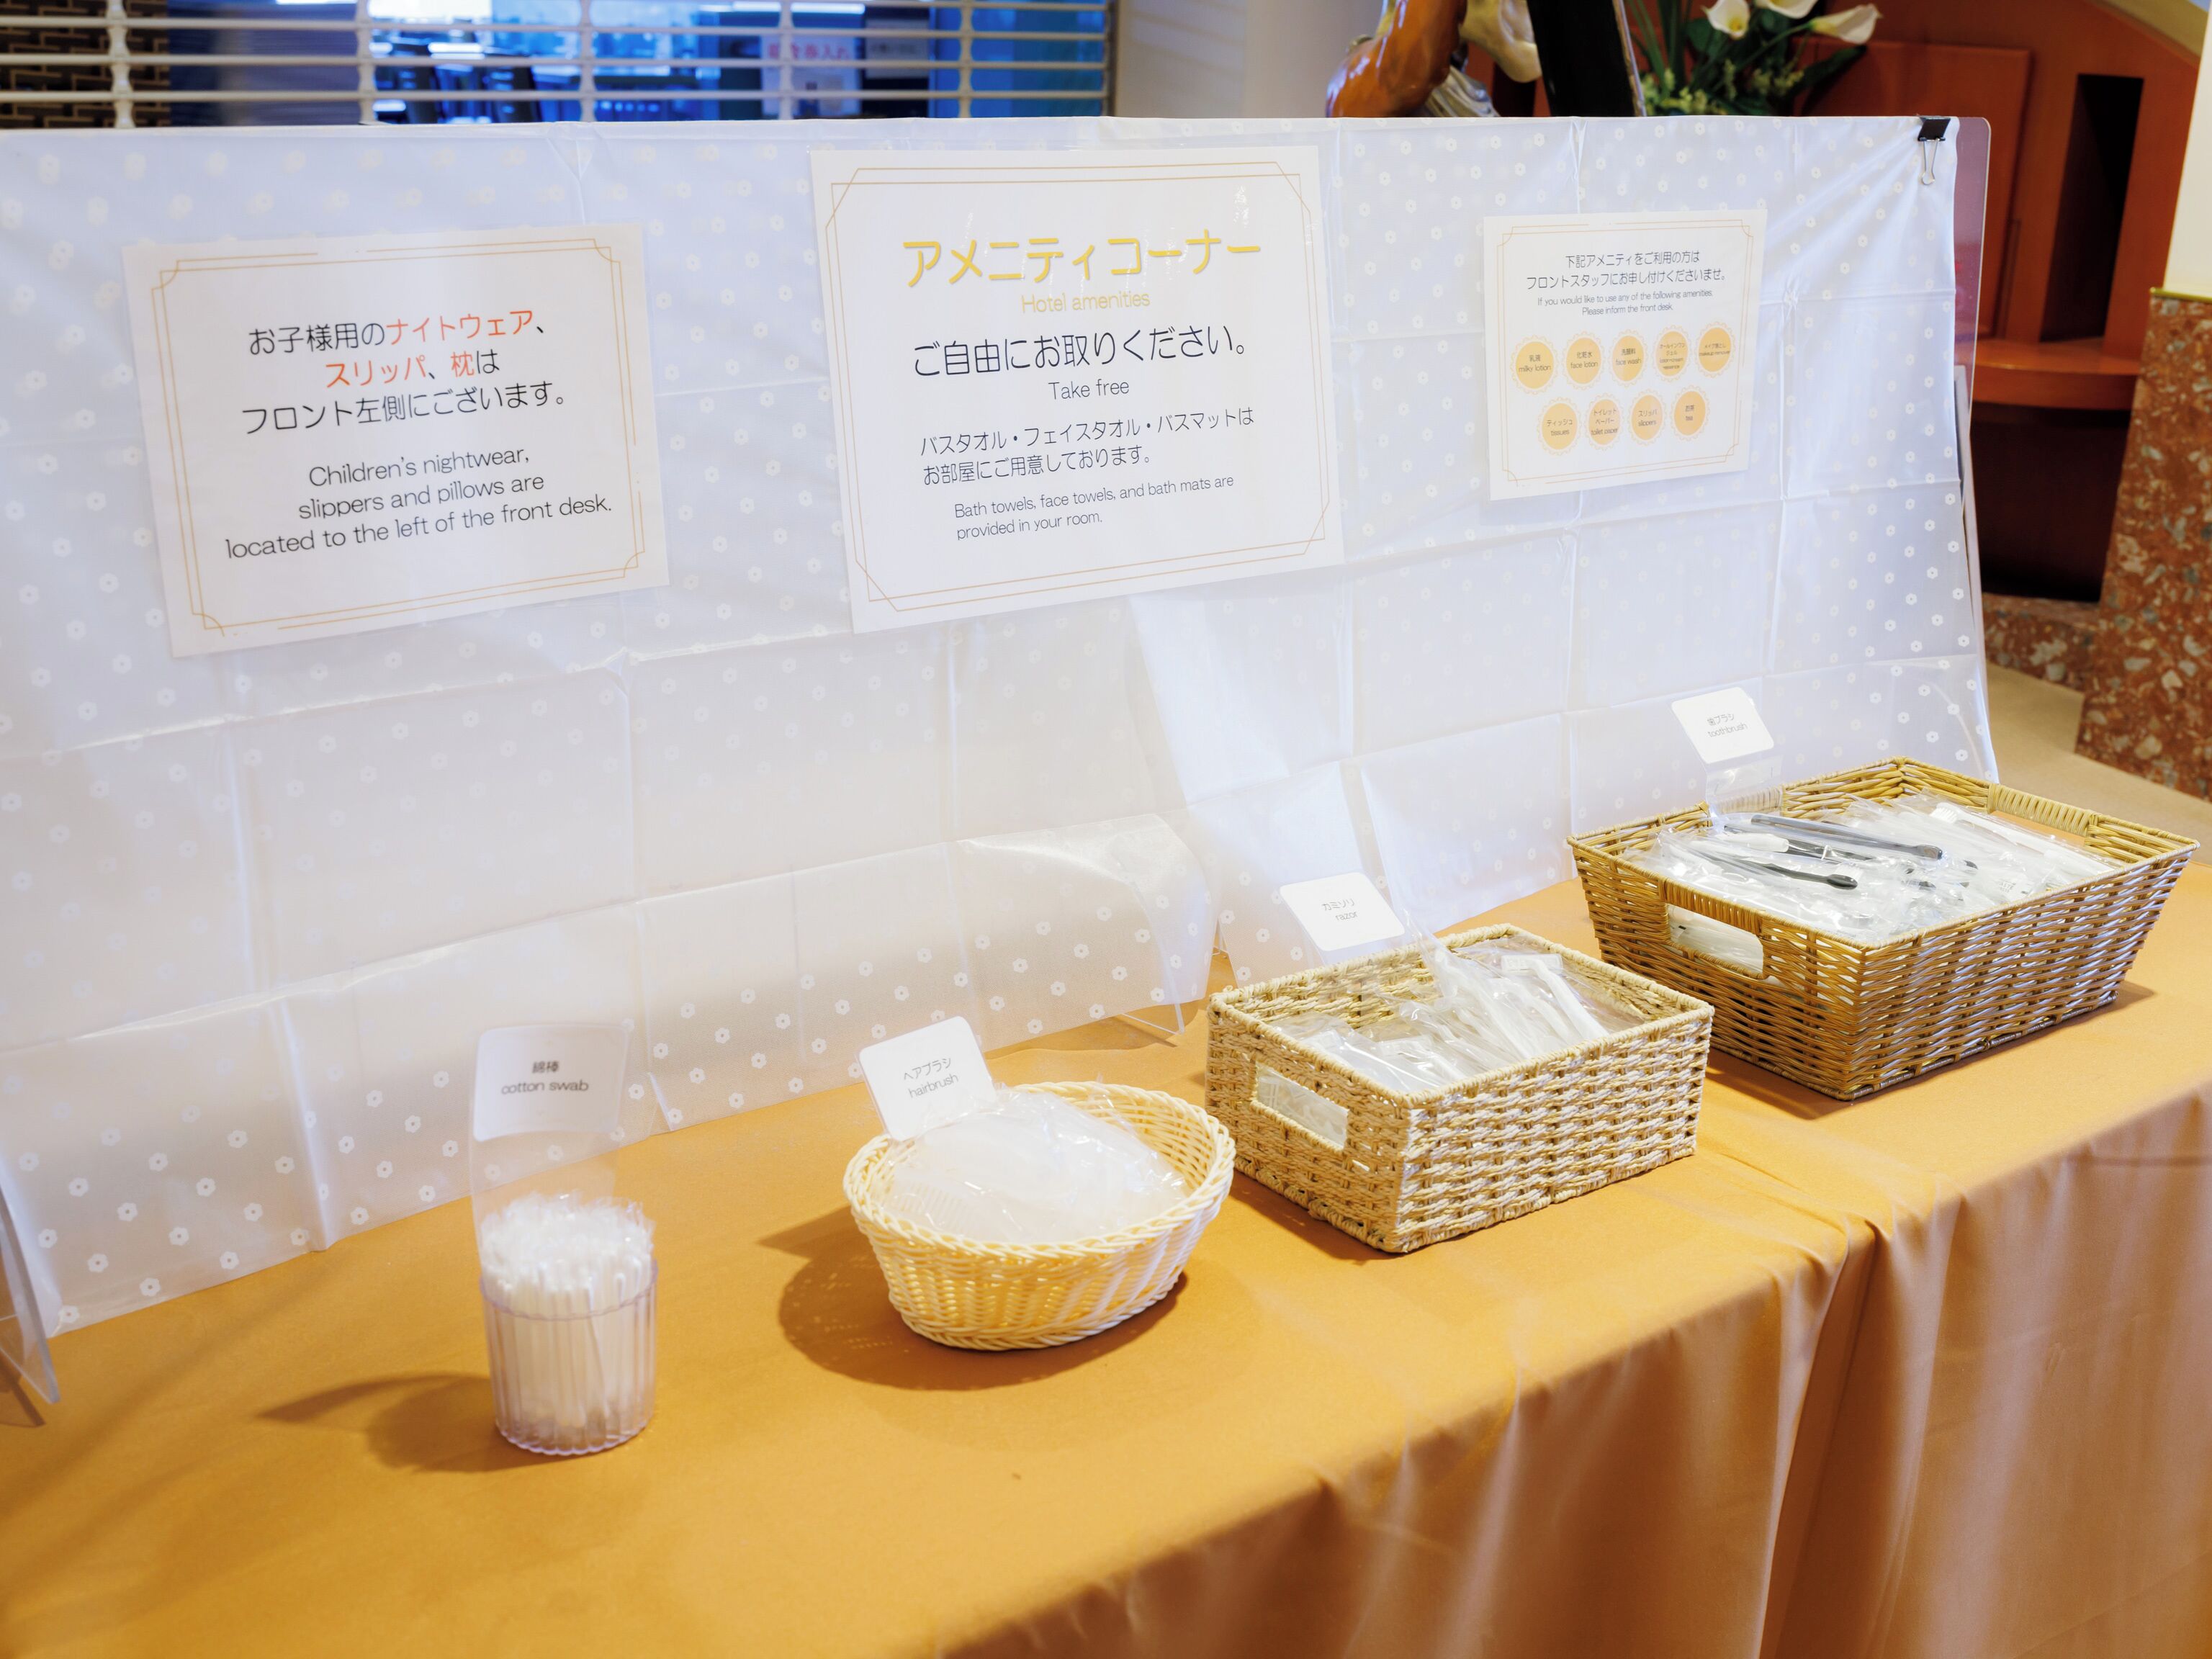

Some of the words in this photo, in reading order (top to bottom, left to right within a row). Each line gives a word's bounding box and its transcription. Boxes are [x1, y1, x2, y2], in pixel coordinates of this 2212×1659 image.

[903, 229, 1261, 287] アメニティコーナー
[1565, 251, 1699, 268] 下記アメニティをご利用の方は
[1527, 269, 1725, 289] フロントスタッフにお申し付けくださいませ。
[1021, 292, 1066, 312] Hotel
[1072, 291, 1150, 310] amenities
[1537, 297, 1542, 306] If
[1560, 295, 1582, 305] would
[1583, 295, 1595, 304] like
[1630, 292, 1638, 301] of
[1653, 290, 1681, 300] following
[1582, 307, 1604, 316] Please
[1605, 305, 1625, 314] inform
[1627, 305, 1638, 313] the
[1640, 303, 1656, 312] front
[249, 309, 546, 356] お子様用のナイトウェア、
[914, 325, 1244, 376] ご自由にお取りください。
[325, 349, 500, 387] スリッパ、枕は
[1048, 381, 1089, 400] Take
[1096, 379, 1129, 396] free
[242, 379, 565, 435] フロント左側にございます。
[921, 407, 1254, 456] バスタオル・フェイスタオル・バスマットは
[423, 449, 529, 473] nightwear,
[923, 444, 1151, 486] お部屋にご用意しております。
[298, 491, 384, 521] slippers
[391, 485, 431, 508] and
[438, 481, 504, 504] pillows
[512, 477, 544, 492] are
[955, 502, 986, 518] Bath
[991, 497, 1036, 513] towels,
[1040, 495, 1069, 508] face
[1073, 487, 1115, 504] towels,
[1120, 484, 1144, 498] and
[1148, 480, 1176, 495] bath
[1181, 478, 1210, 492] mats
[1215, 477, 1233, 487] are
[225, 530, 315, 559] located
[323, 531, 346, 547] to
[353, 523, 389, 543] the
[395, 516, 429, 538] left
[435, 512, 454, 532] of
[462, 509, 494, 528] the
[501, 502, 553, 523] front
[559, 494, 611, 516] desk.
[957, 519, 1015, 540] provided
[1019, 519, 1030, 531] in
[1034, 517, 1062, 531] your
[1067, 513, 1102, 526] room.
[1708, 722, 1748, 737] toothbrush
[1322, 898, 1354, 911] カミソリ
[1336, 911, 1357, 921] razor
[904, 1058, 951, 1080] ヘアブラシ
[501, 1082, 545, 1094] cotton
[549, 1079, 589, 1092] swab
[908, 1074, 958, 1098] hairbrush
